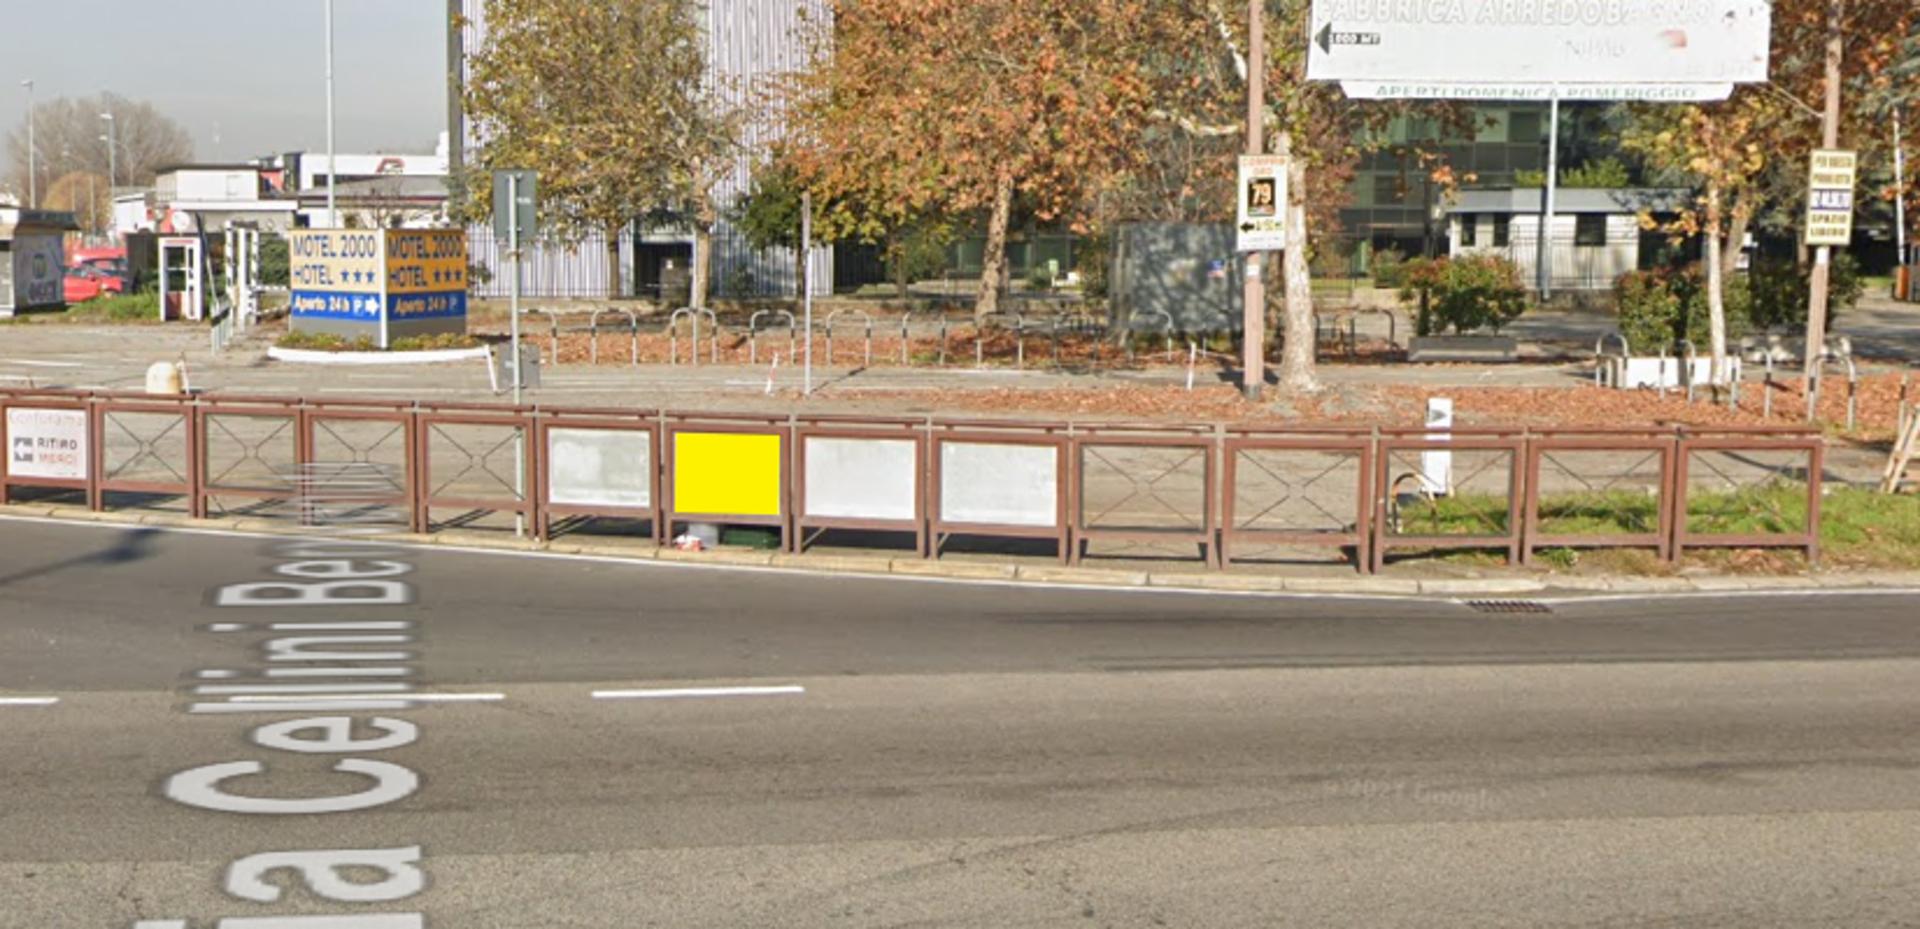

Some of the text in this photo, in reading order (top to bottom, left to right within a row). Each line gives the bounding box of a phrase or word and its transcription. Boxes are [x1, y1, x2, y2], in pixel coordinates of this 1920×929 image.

[1316, 0, 1465, 23] FABBRICA
[1375, 85, 1697, 98] APERTI DOMENICA POMERIGGIO
[1252, 183, 1272, 205] 79
[293, 234, 376, 258] MOTEL 2000
[388, 234, 463, 259] MOTEL 2000
[293, 264, 334, 286] HOTEL
[390, 264, 428, 287] HOTEL
[293, 294, 327, 313] Aperto
[394, 296, 425, 315] Aperto
[38, 437, 78, 450] RITIRO
